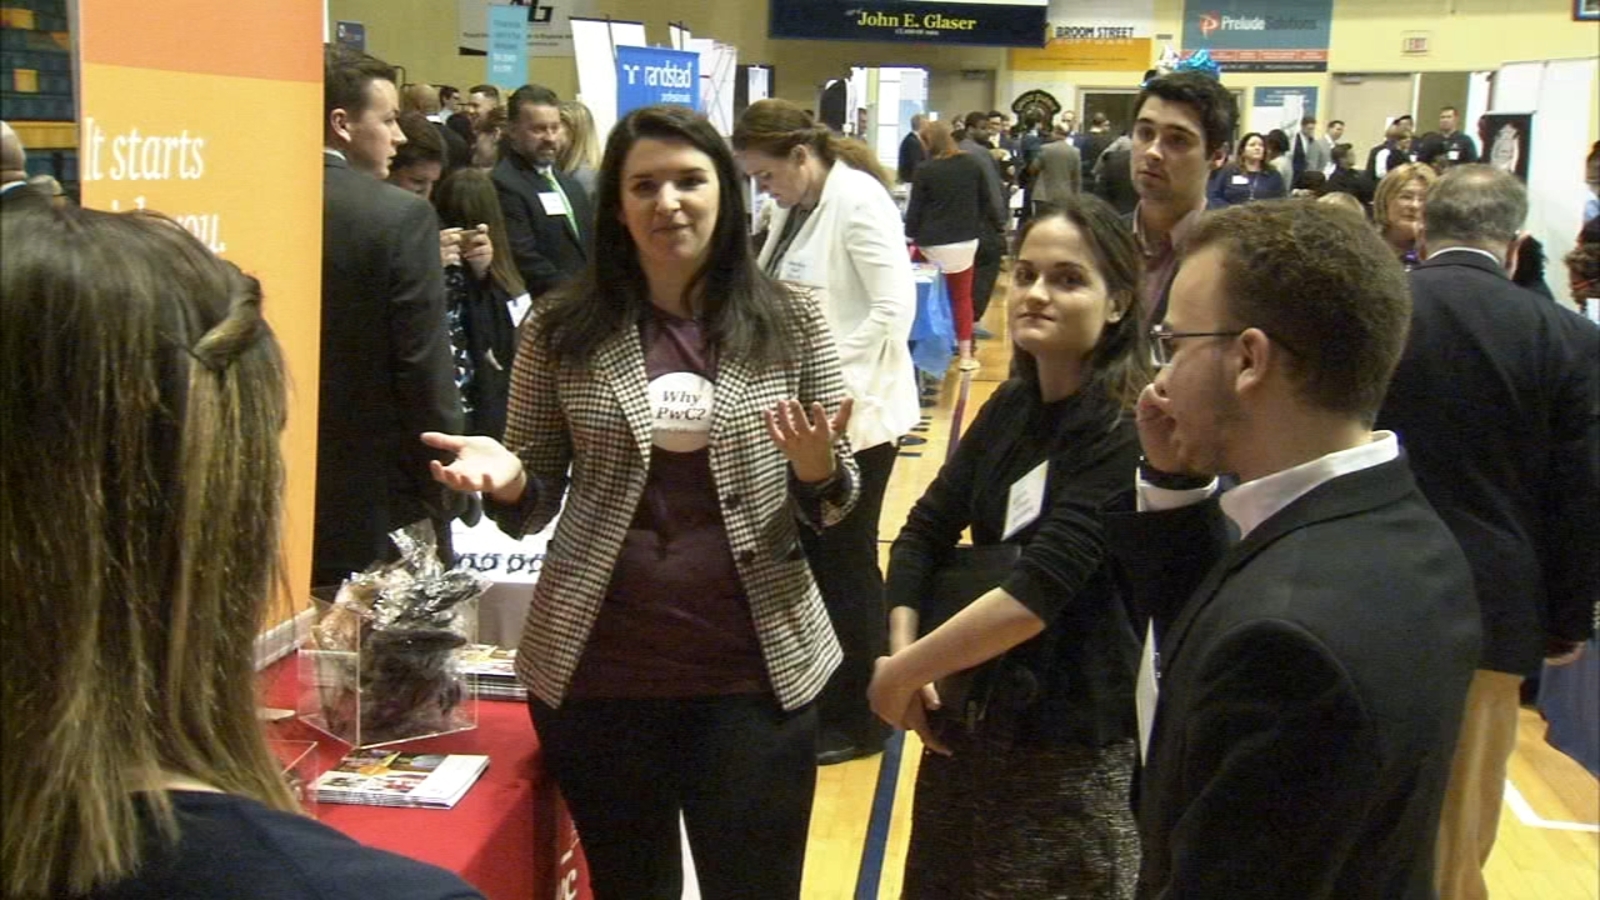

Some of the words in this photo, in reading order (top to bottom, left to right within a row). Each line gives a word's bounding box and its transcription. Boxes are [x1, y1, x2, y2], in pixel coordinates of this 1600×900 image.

[857, 11, 899, 27] John
[903, 13, 920, 28] E.
[923, 13, 977, 30] Glaser
[1221, 15, 1265, 30] Prelude
[1056, 26, 1095, 38] BROOM
[1097, 26, 1134, 38] STREET
[644, 59, 692, 88] randstad
[84, 116, 105, 181] It
[110, 127, 207, 181] starts
[177, 212, 226, 253] ou.
[662, 390, 703, 406] Why
